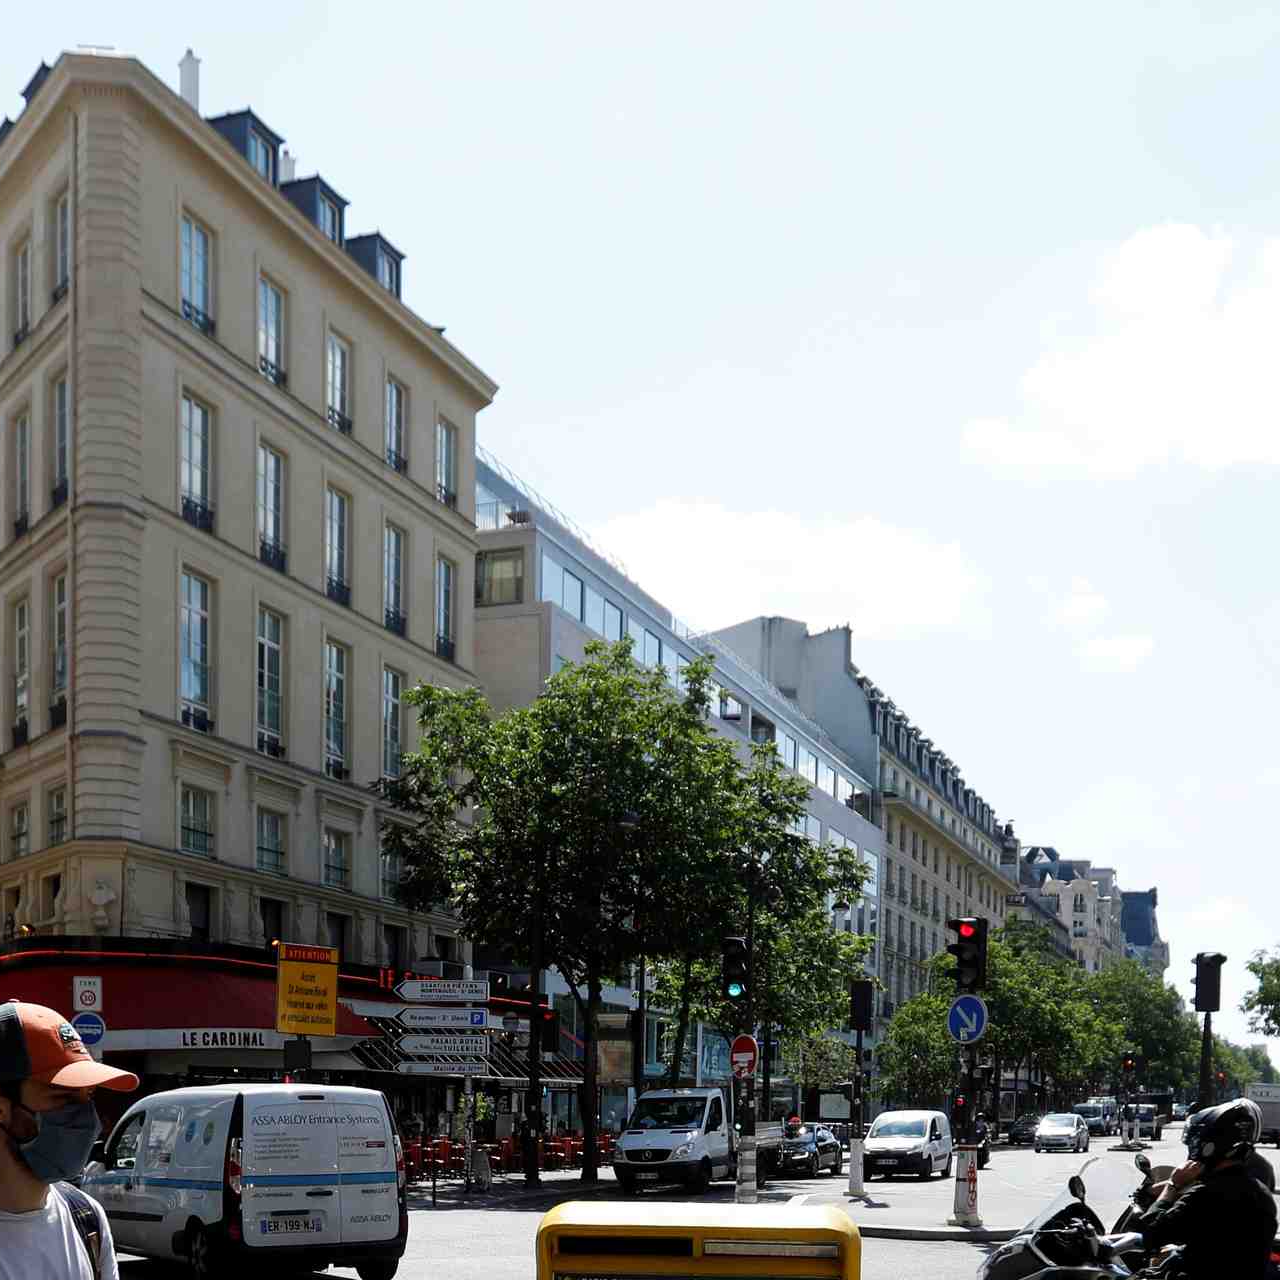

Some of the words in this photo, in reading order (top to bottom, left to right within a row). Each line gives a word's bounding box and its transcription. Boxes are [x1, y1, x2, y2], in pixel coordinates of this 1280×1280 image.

[289, 949, 330, 961] ATTENTION
[182, 1031, 197, 1046] LE
[202, 1031, 265, 1046] CARDINAL
[252, 1115, 276, 1126] ASSA
[277, 1114, 308, 1125] ABLOY
[309, 1114, 346, 1125] Entrance
[347, 1114, 380, 1127] Systems
